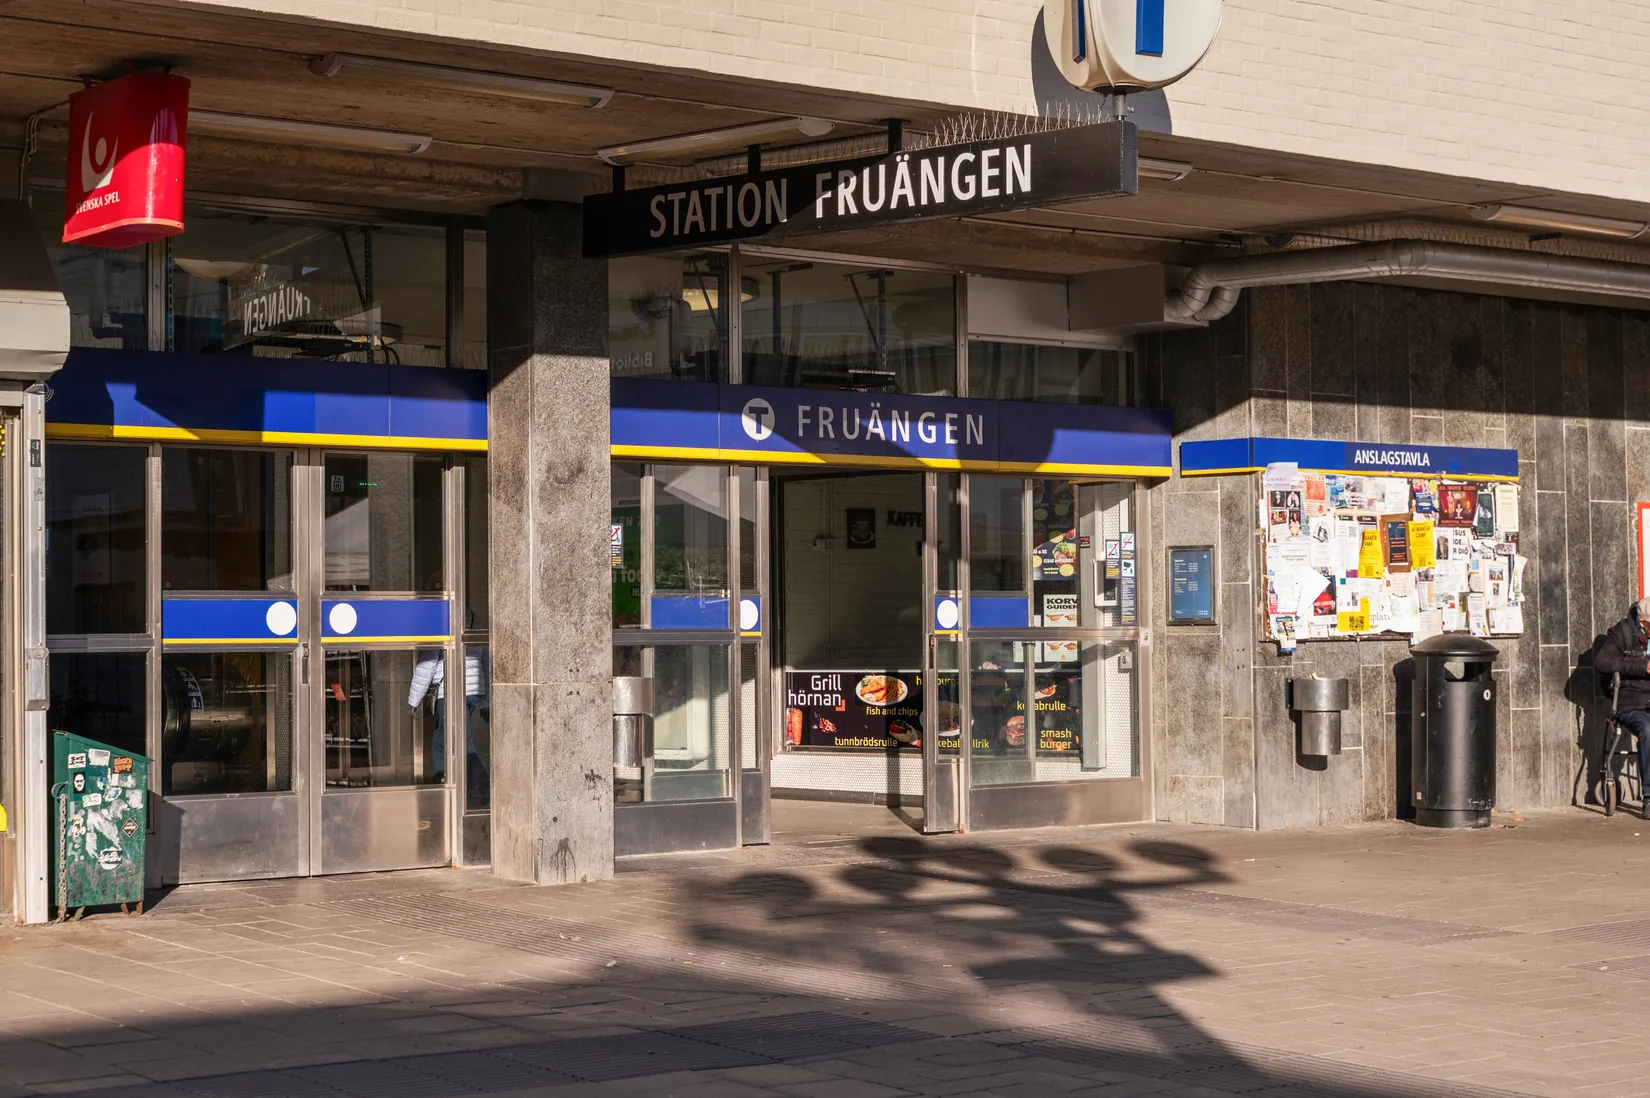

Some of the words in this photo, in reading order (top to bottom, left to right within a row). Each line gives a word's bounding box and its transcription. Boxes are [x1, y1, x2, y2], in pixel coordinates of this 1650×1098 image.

[649, 178, 788, 239] STATION
[815, 143, 1032, 219] FRUÄNGEN
[75, 195, 103, 215] SVENSKA
[104, 191, 120, 206] SPEL
[797, 402, 984, 446] FRUÄNGEN
[1354, 449, 1431, 467] ANSLAGSTAVLA
[811, 674, 842, 691] Grill
[788, 689, 842, 706] hörnan
[1016, 700, 1067, 711] keabrulle
[866, 706, 881, 716] fish
[882, 707, 896, 716] and
[897, 707, 918, 717] chips
[834, 736, 898, 748] tunnbrödsrulle
[1040, 728, 1072, 739] smash
[1040, 739, 1072, 751] burger
